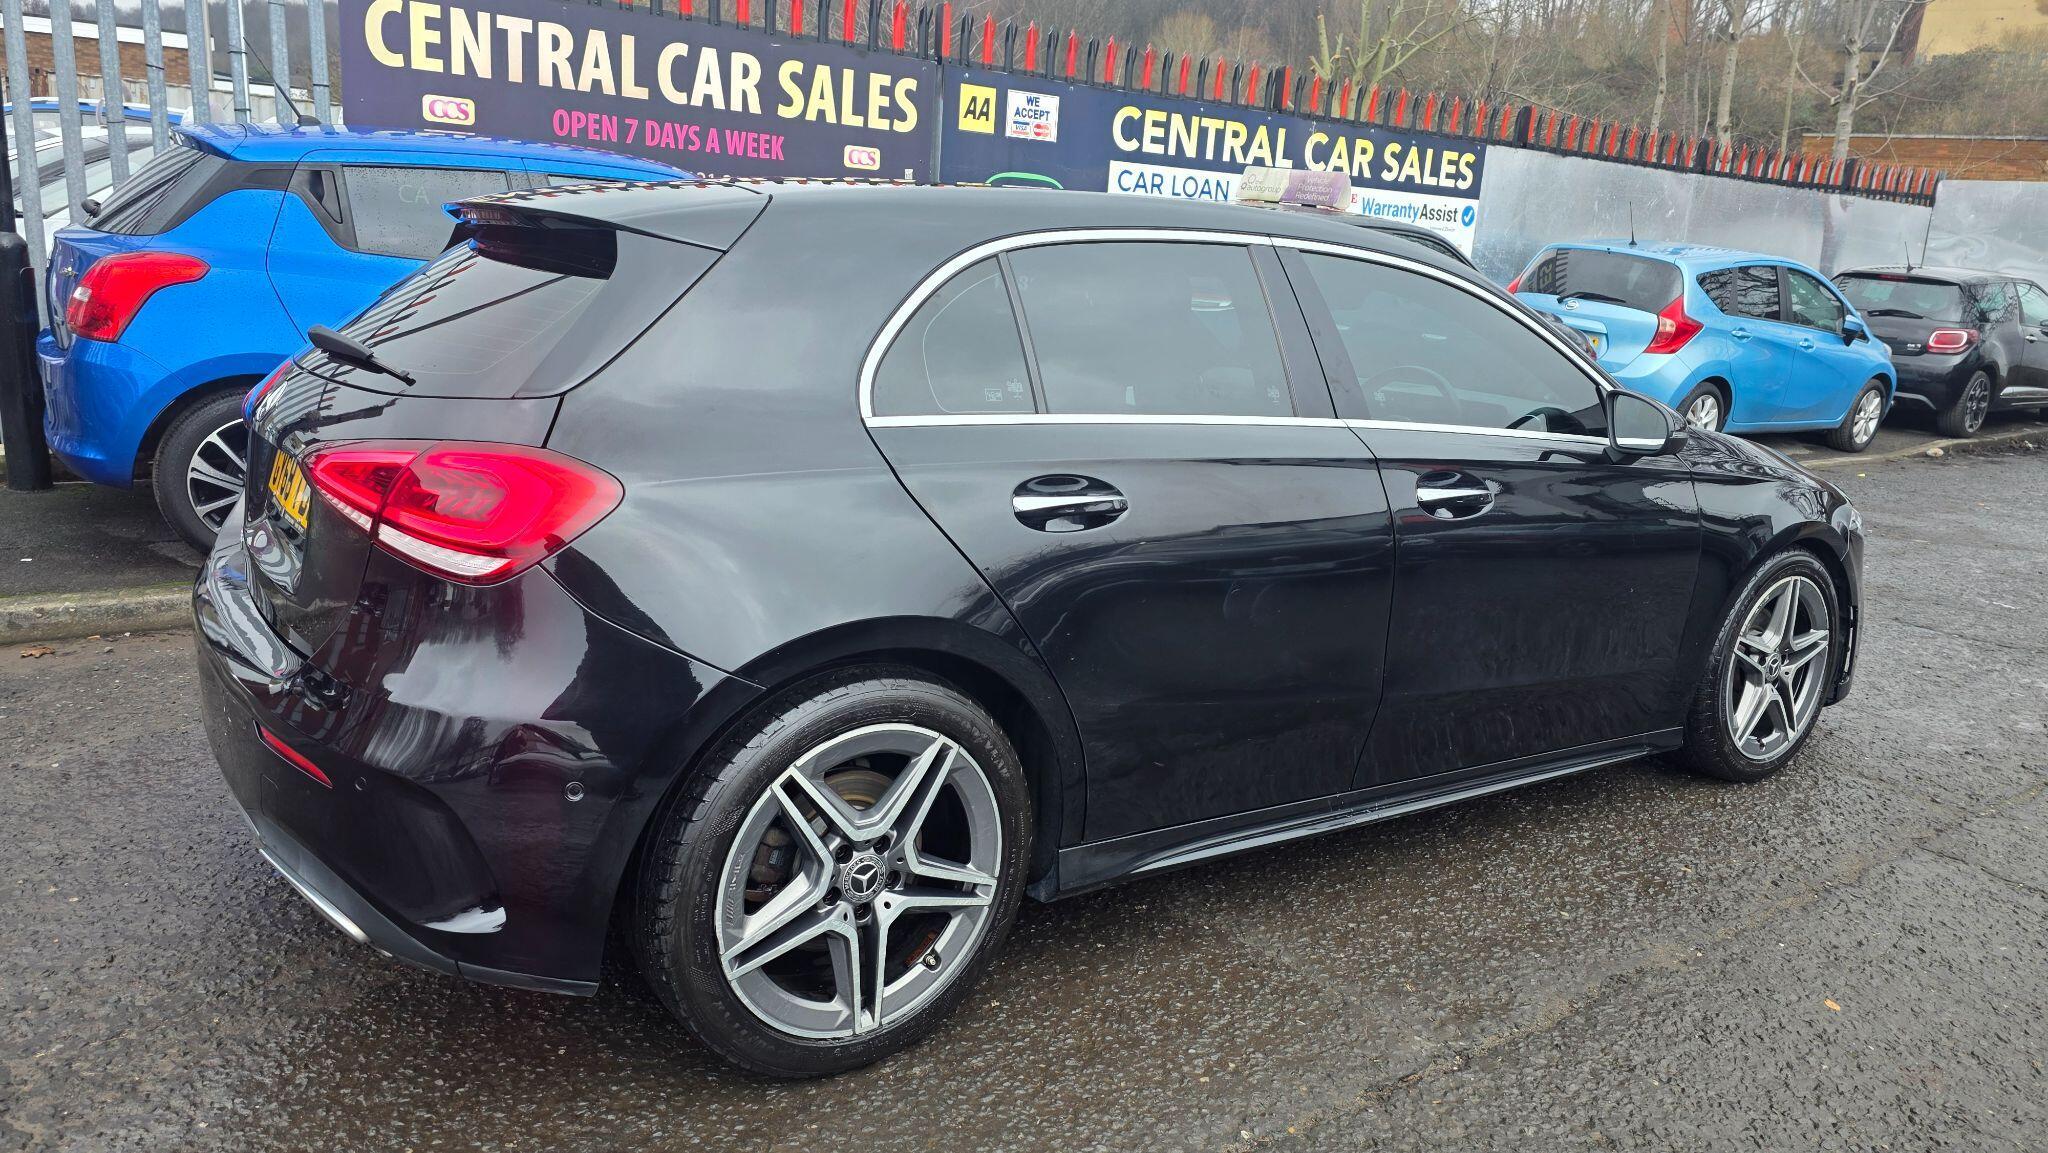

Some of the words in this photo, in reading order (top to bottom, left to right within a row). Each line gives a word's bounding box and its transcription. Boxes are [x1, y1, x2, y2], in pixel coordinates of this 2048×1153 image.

[364, 0, 649, 100] CENTRAL
[657, 42, 762, 115] CAR
[777, 59, 918, 133] SALES
[429, 99, 470, 121] CCS
[963, 95, 991, 122] AA
[1014, 106, 1051, 121] ACCEPT
[1026, 95, 1041, 107] WE
[552, 108, 618, 142] OPEN
[624, 118, 639, 144] 7
[645, 119, 702, 151] DAYS
[705, 127, 721, 154] A
[725, 129, 785, 161] WEEK
[1112, 106, 1294, 169] CENTRAL
[1303, 131, 1375, 180] CAR
[1381, 141, 1476, 191] SALES
[1117, 169, 1164, 195] CAR
[1171, 175, 1230, 203] LOAN
